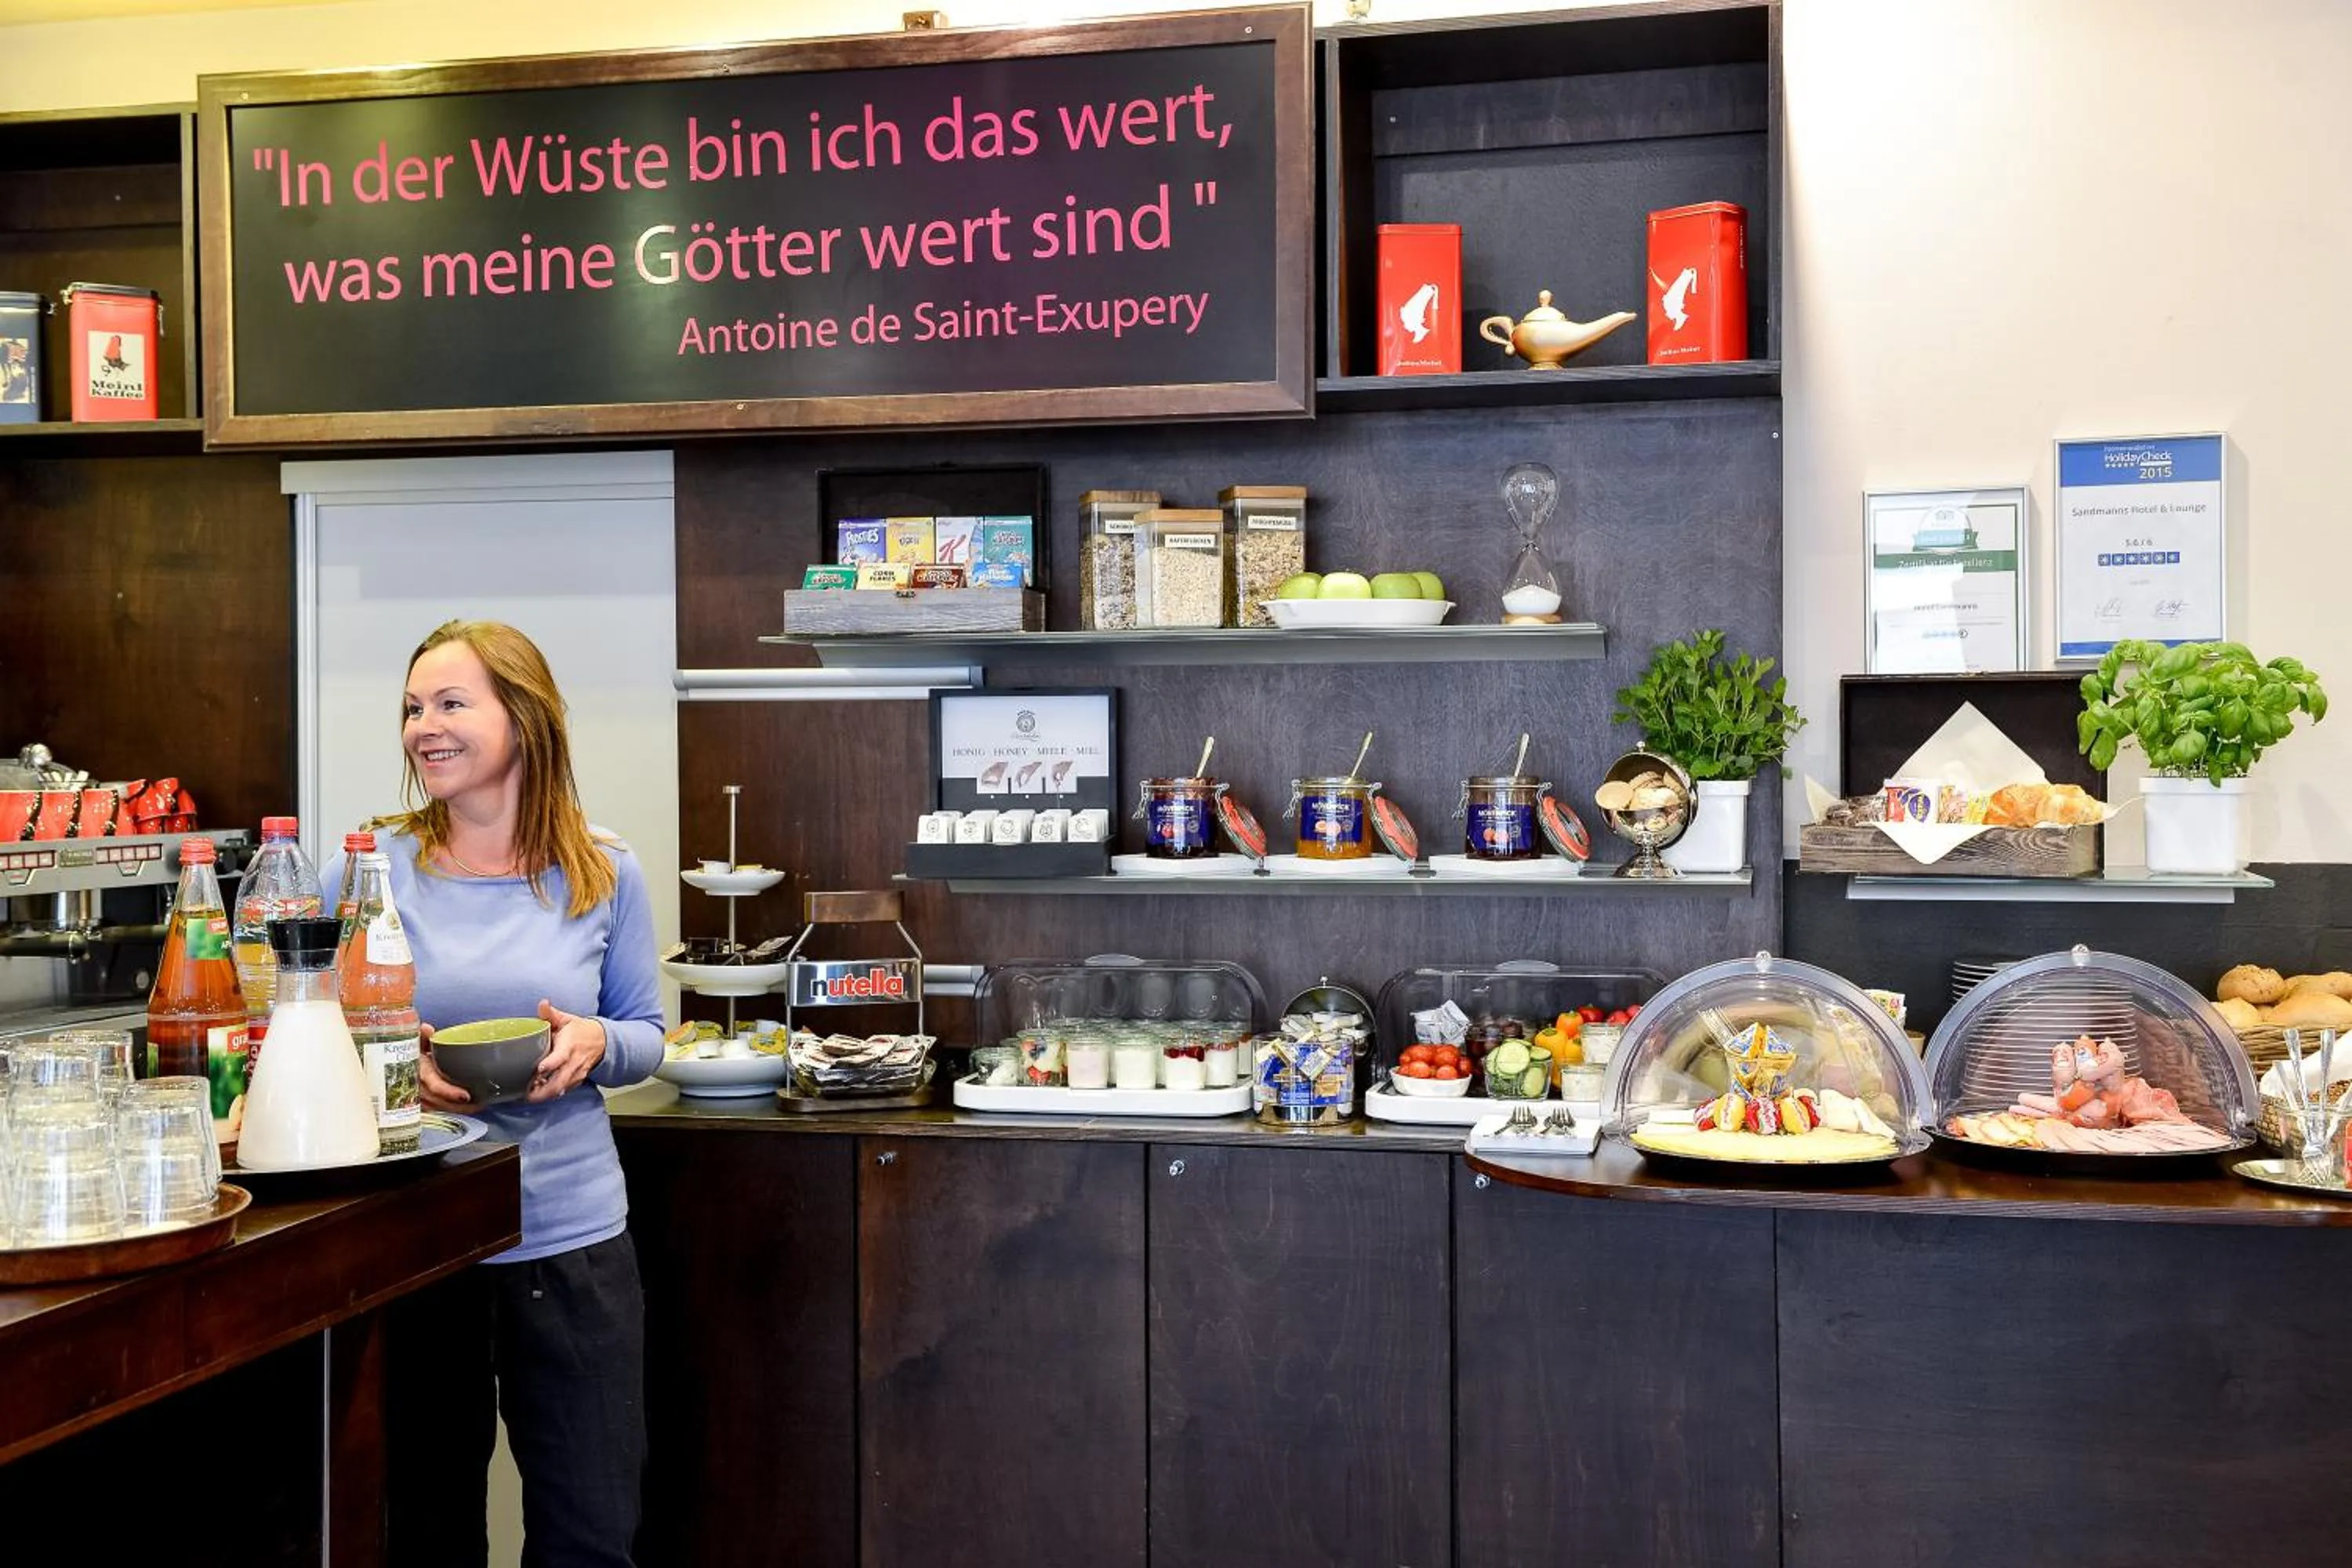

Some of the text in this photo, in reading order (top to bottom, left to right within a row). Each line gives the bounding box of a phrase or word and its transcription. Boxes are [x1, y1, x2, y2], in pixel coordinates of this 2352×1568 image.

[253, 85, 1232, 207] "In der Wüste bin ich das wert,
[284, 255, 402, 303] was
[423, 234, 615, 298] meine
[635, 222, 840, 285] Götter
[860, 207, 1011, 270] wert
[1033, 184, 1171, 259] sind
[678, 292, 1209, 355] Antoine de Saint-Exupery
[91, 379, 143, 390] Meinl
[91, 389, 143, 398] Kaffee
[2104, 451, 2172, 464] HolidayCheck
[2139, 466, 2172, 479] 2015
[2071, 506, 2129, 517] Sandmanns
[2132, 504, 2157, 514] Hotel
[2169, 503, 2207, 514] Lounge
[953, 748, 985, 757] HONIG
[993, 747, 1028, 756] HONEY
[811, 967, 904, 997] nutella
